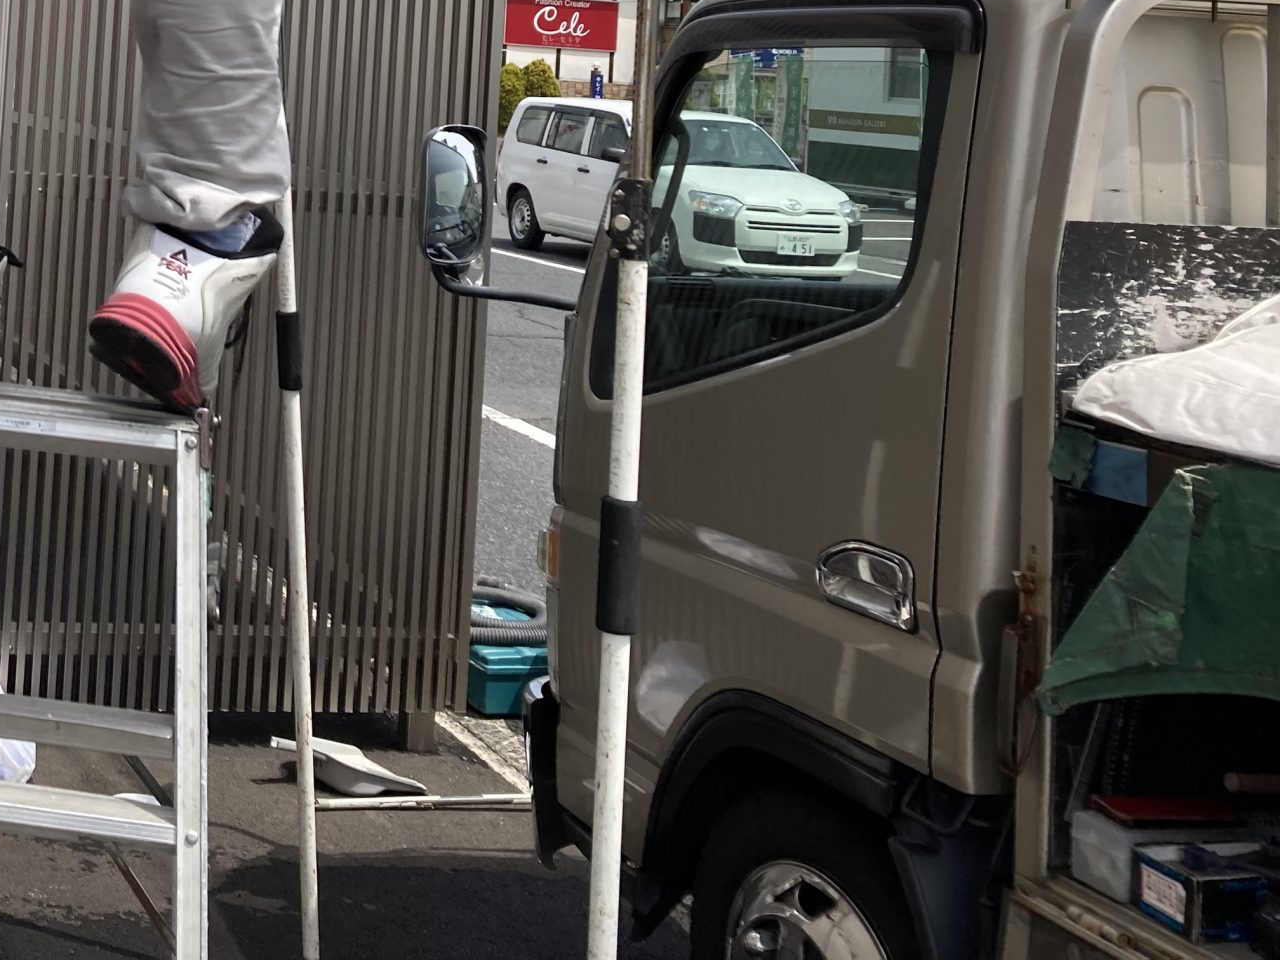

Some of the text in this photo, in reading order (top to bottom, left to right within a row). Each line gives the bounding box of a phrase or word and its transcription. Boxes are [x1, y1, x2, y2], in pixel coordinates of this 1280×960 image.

[564, 0, 591, 9] Creator
[533, 6, 590, 36] Cele
[157, 257, 192, 281] PEAK
